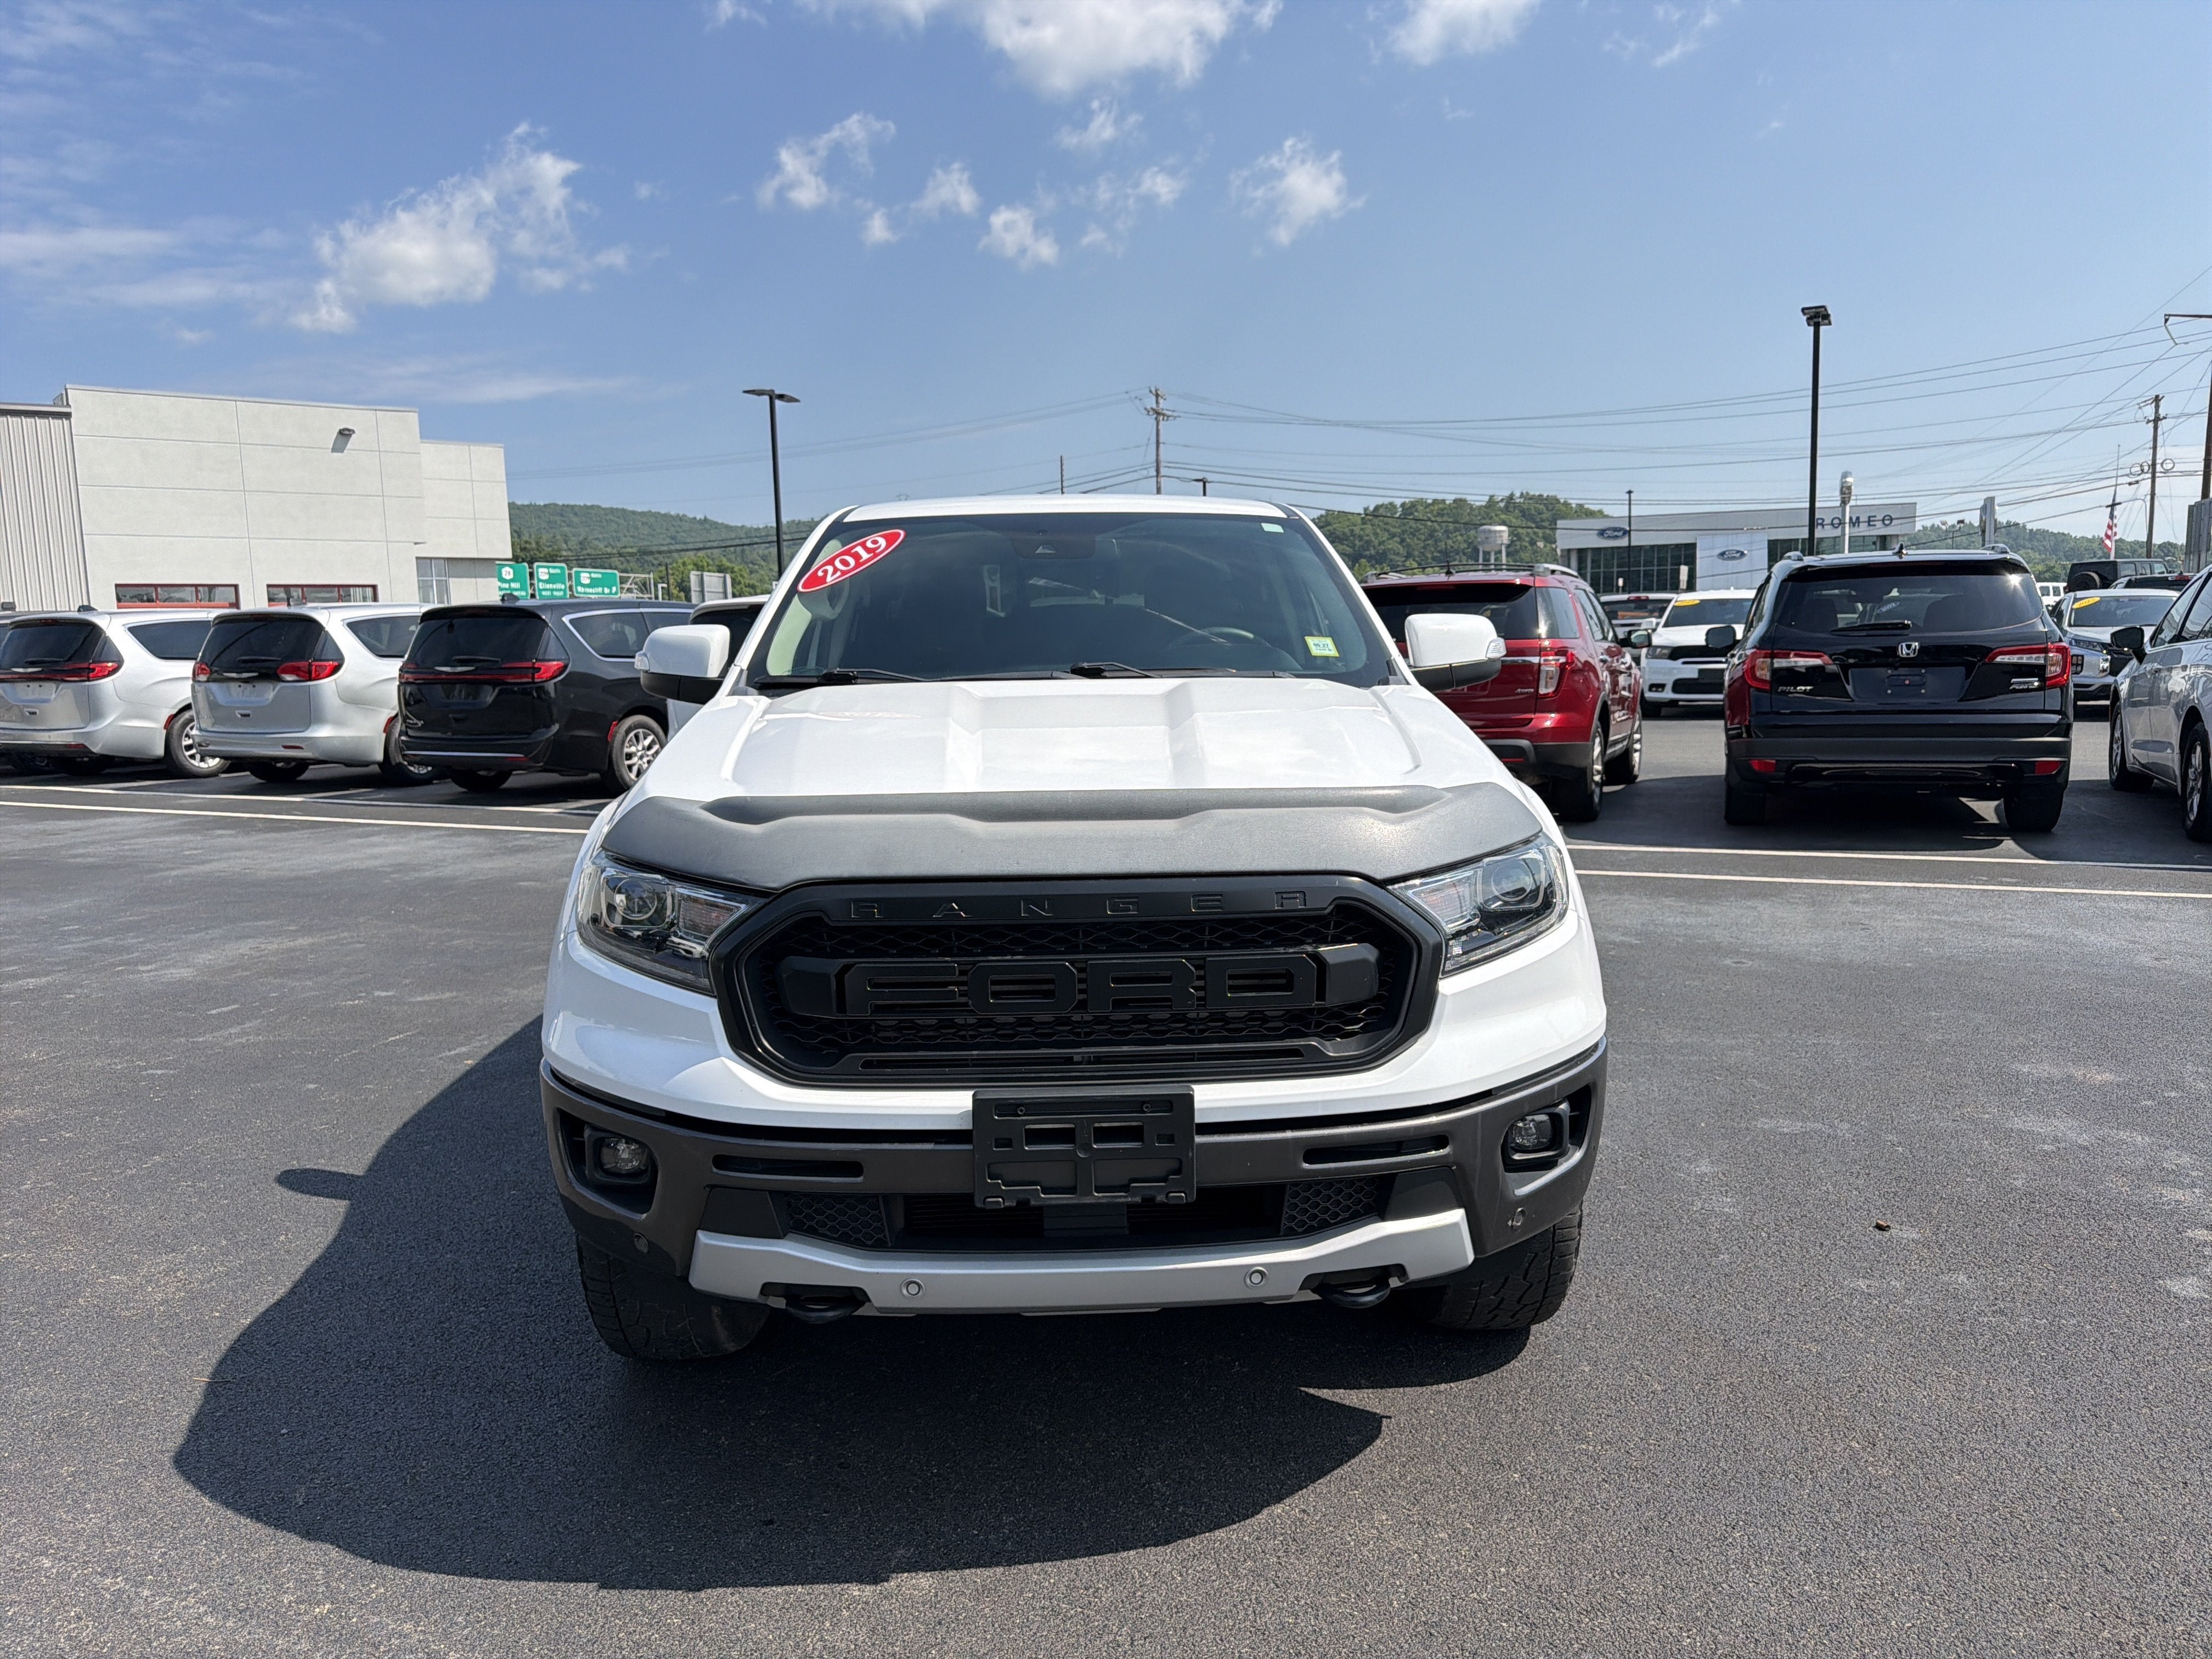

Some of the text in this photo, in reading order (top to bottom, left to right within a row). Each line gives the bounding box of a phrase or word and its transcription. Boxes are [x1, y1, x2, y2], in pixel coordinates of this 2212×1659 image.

[1816, 514, 1893, 529] ROMEO
[817, 537, 887, 583] 2019
[851, 891, 1306, 918] RANGER
[844, 953, 1317, 1015] FORD
